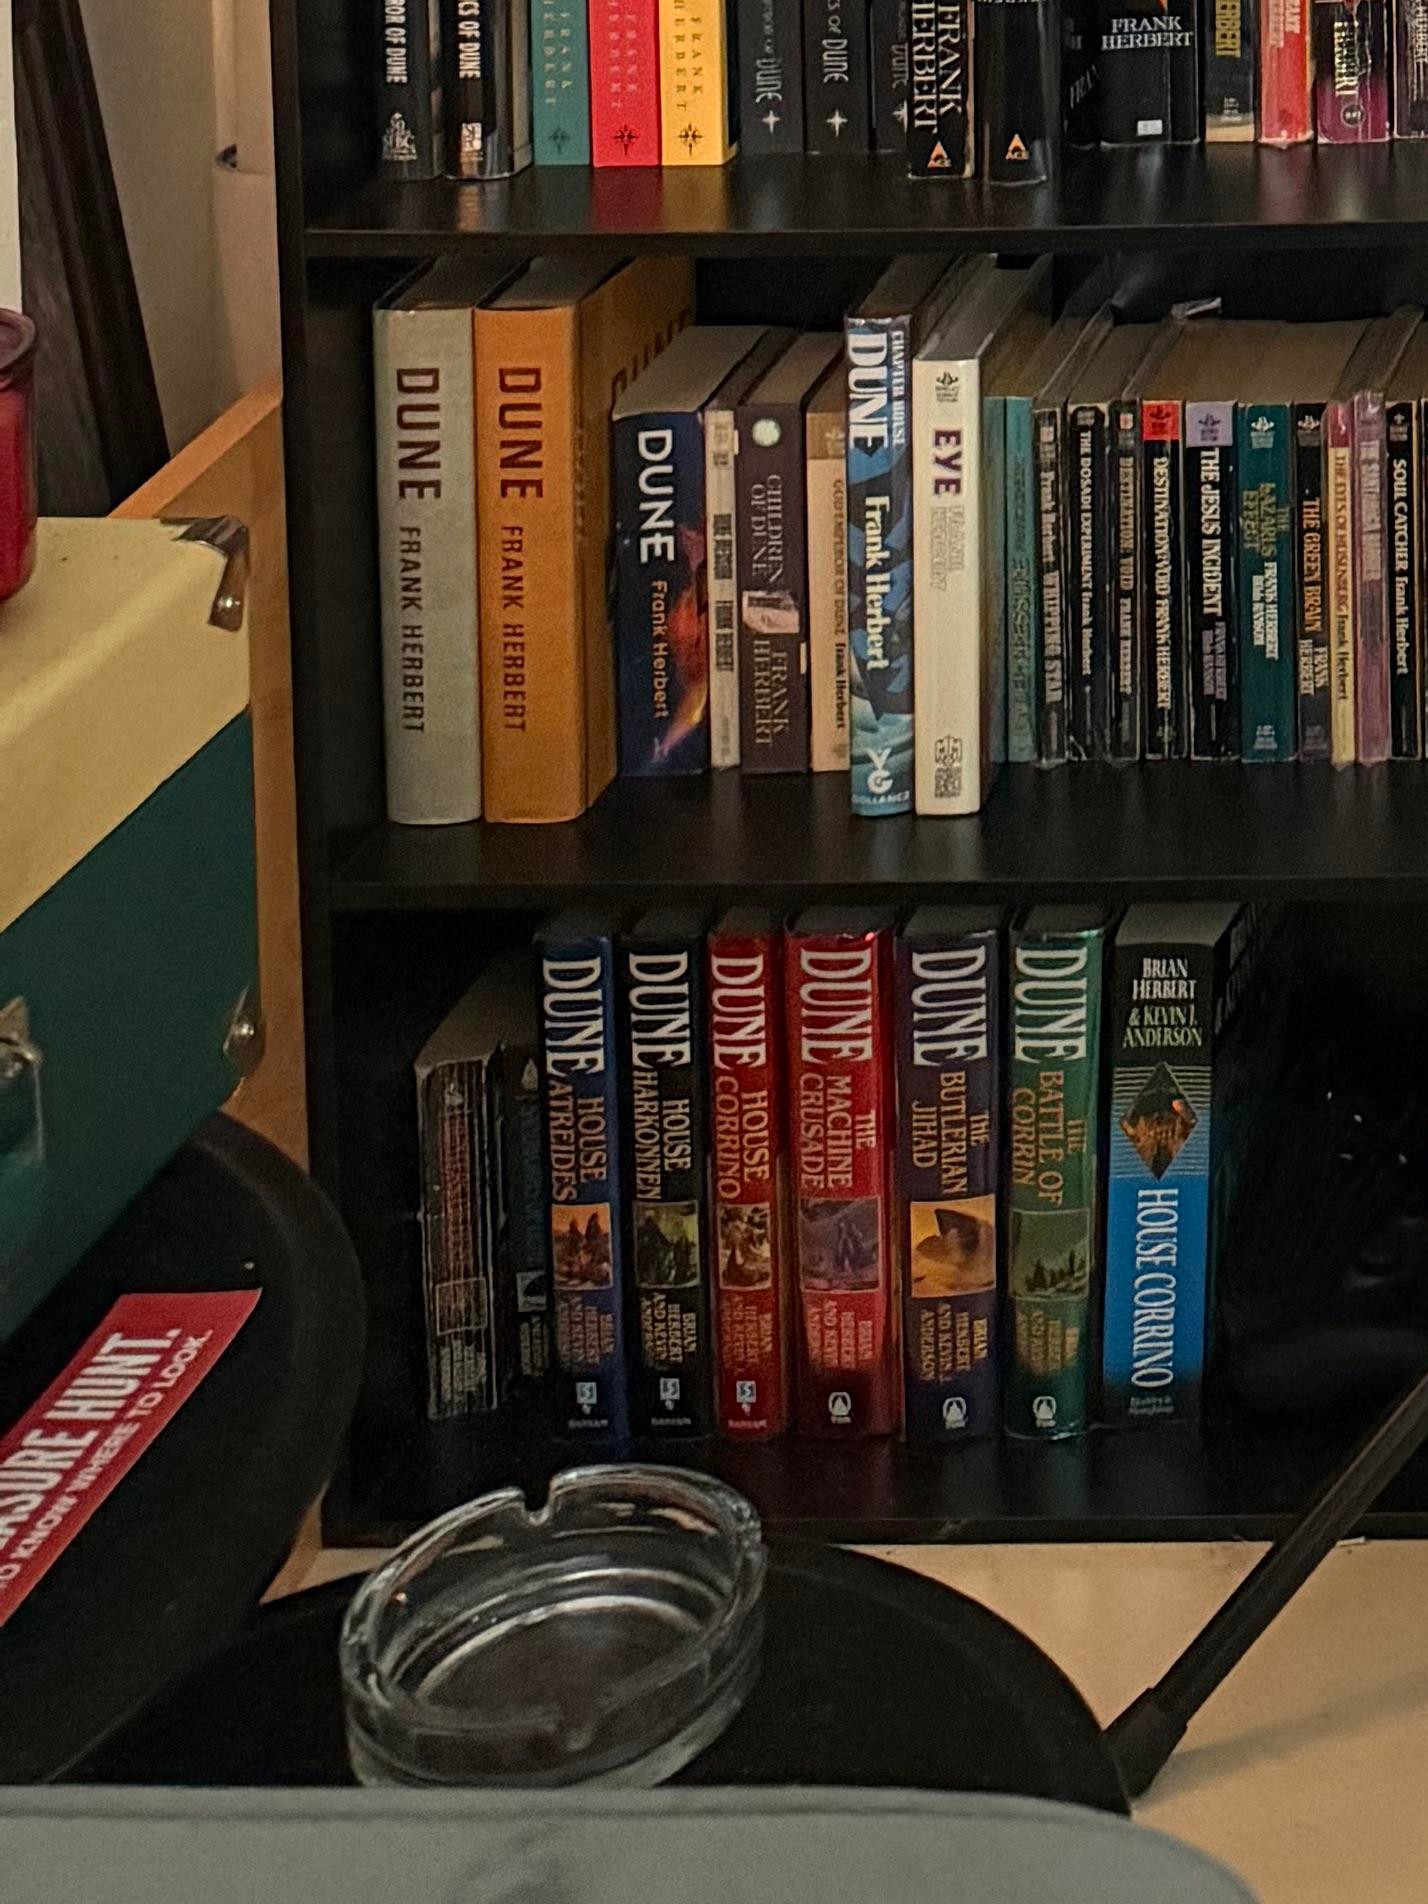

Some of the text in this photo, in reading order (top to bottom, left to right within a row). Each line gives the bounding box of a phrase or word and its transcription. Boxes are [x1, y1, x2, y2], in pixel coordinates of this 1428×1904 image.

[1100, 31, 1193, 50] HERBERT
[1110, 16, 1183, 33] FRANK
[637, 429, 675, 565] DUNE
[933, 429, 963, 496] EYE
[396, 367, 442, 734] DUNE FRANK HERBERT
[498, 366, 544, 733] DUNE FRANK HERBERT
[862, 495, 892, 671] Frank Herbert
[543, 958, 604, 1077] DUNE
[546, 1077, 579, 1203] ATREIDES
[576, 1096, 606, 1184] HOUSE
[1132, 1187, 1178, 1390] HOUSE CORRINO
